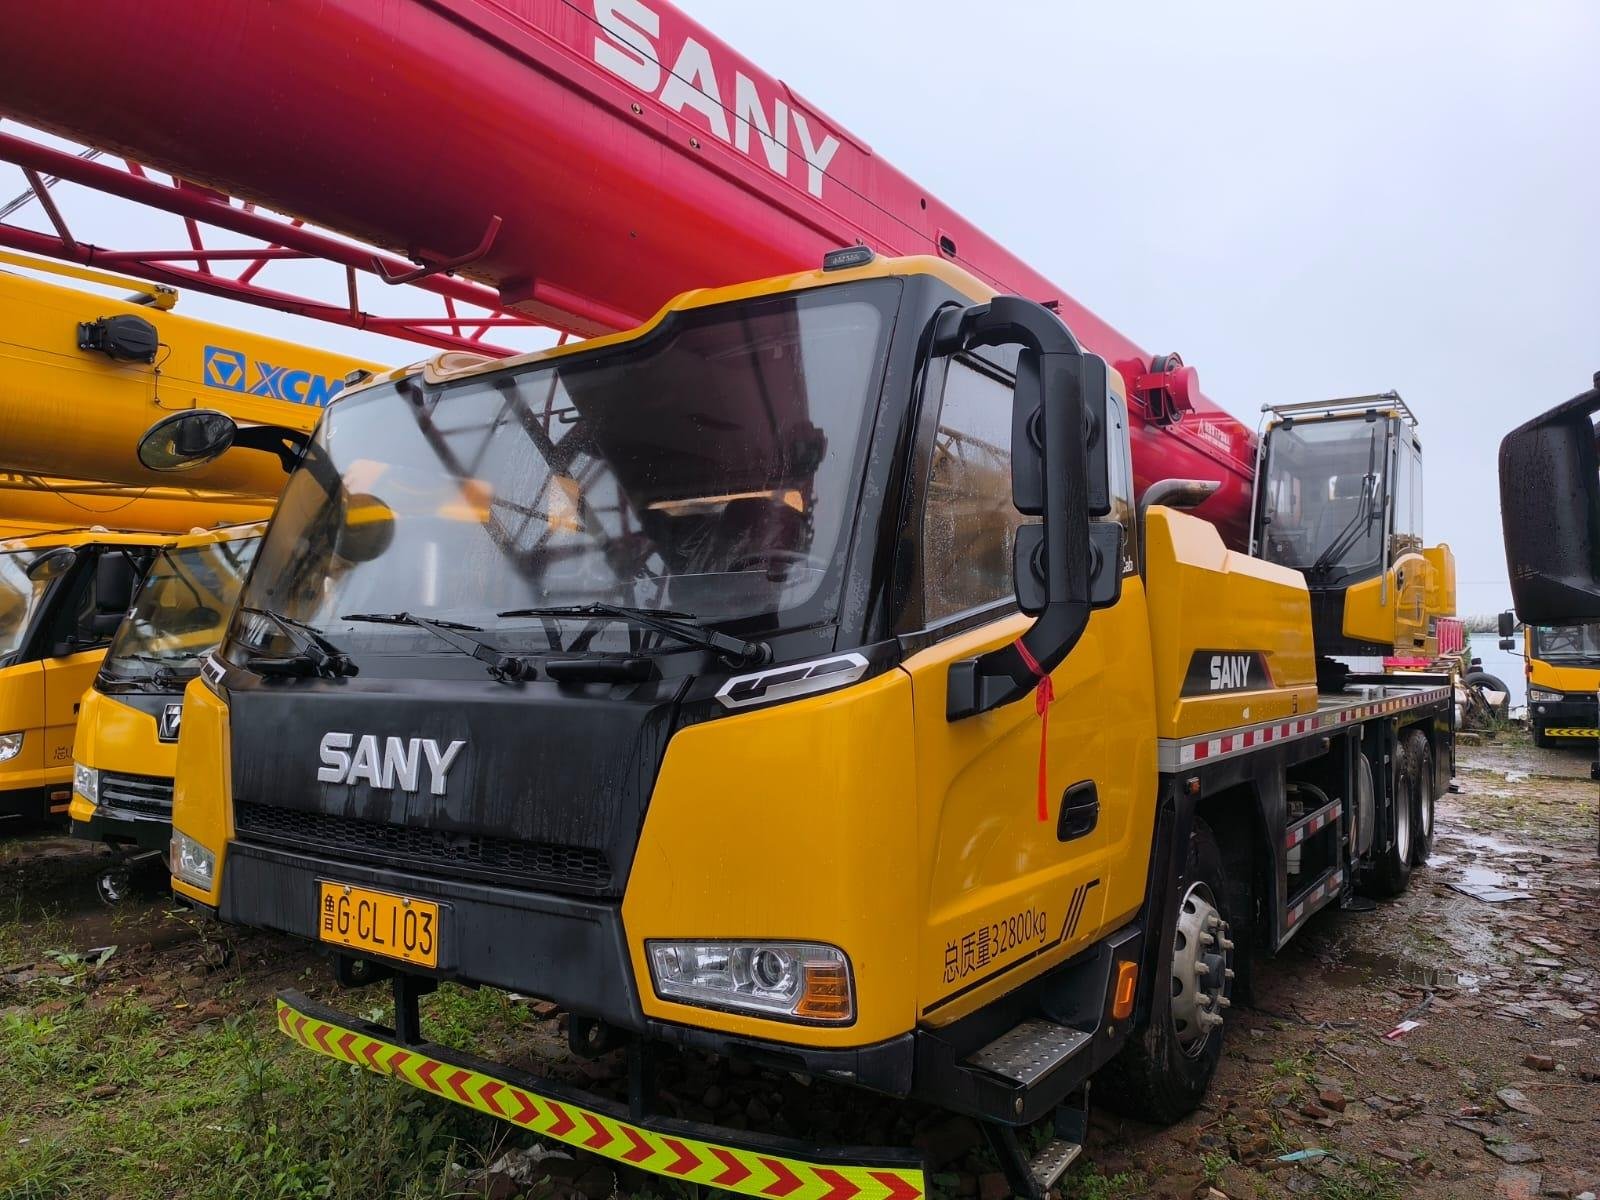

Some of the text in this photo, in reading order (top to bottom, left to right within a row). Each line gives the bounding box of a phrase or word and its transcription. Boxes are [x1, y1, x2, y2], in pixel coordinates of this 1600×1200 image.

[594, 0, 840, 199] SANY
[249, 361, 345, 408] XCM
[1210, 656, 1251, 690] SANY
[317, 732, 467, 795] SANY
[943, 906, 1047, 984] 总质量32800kg
